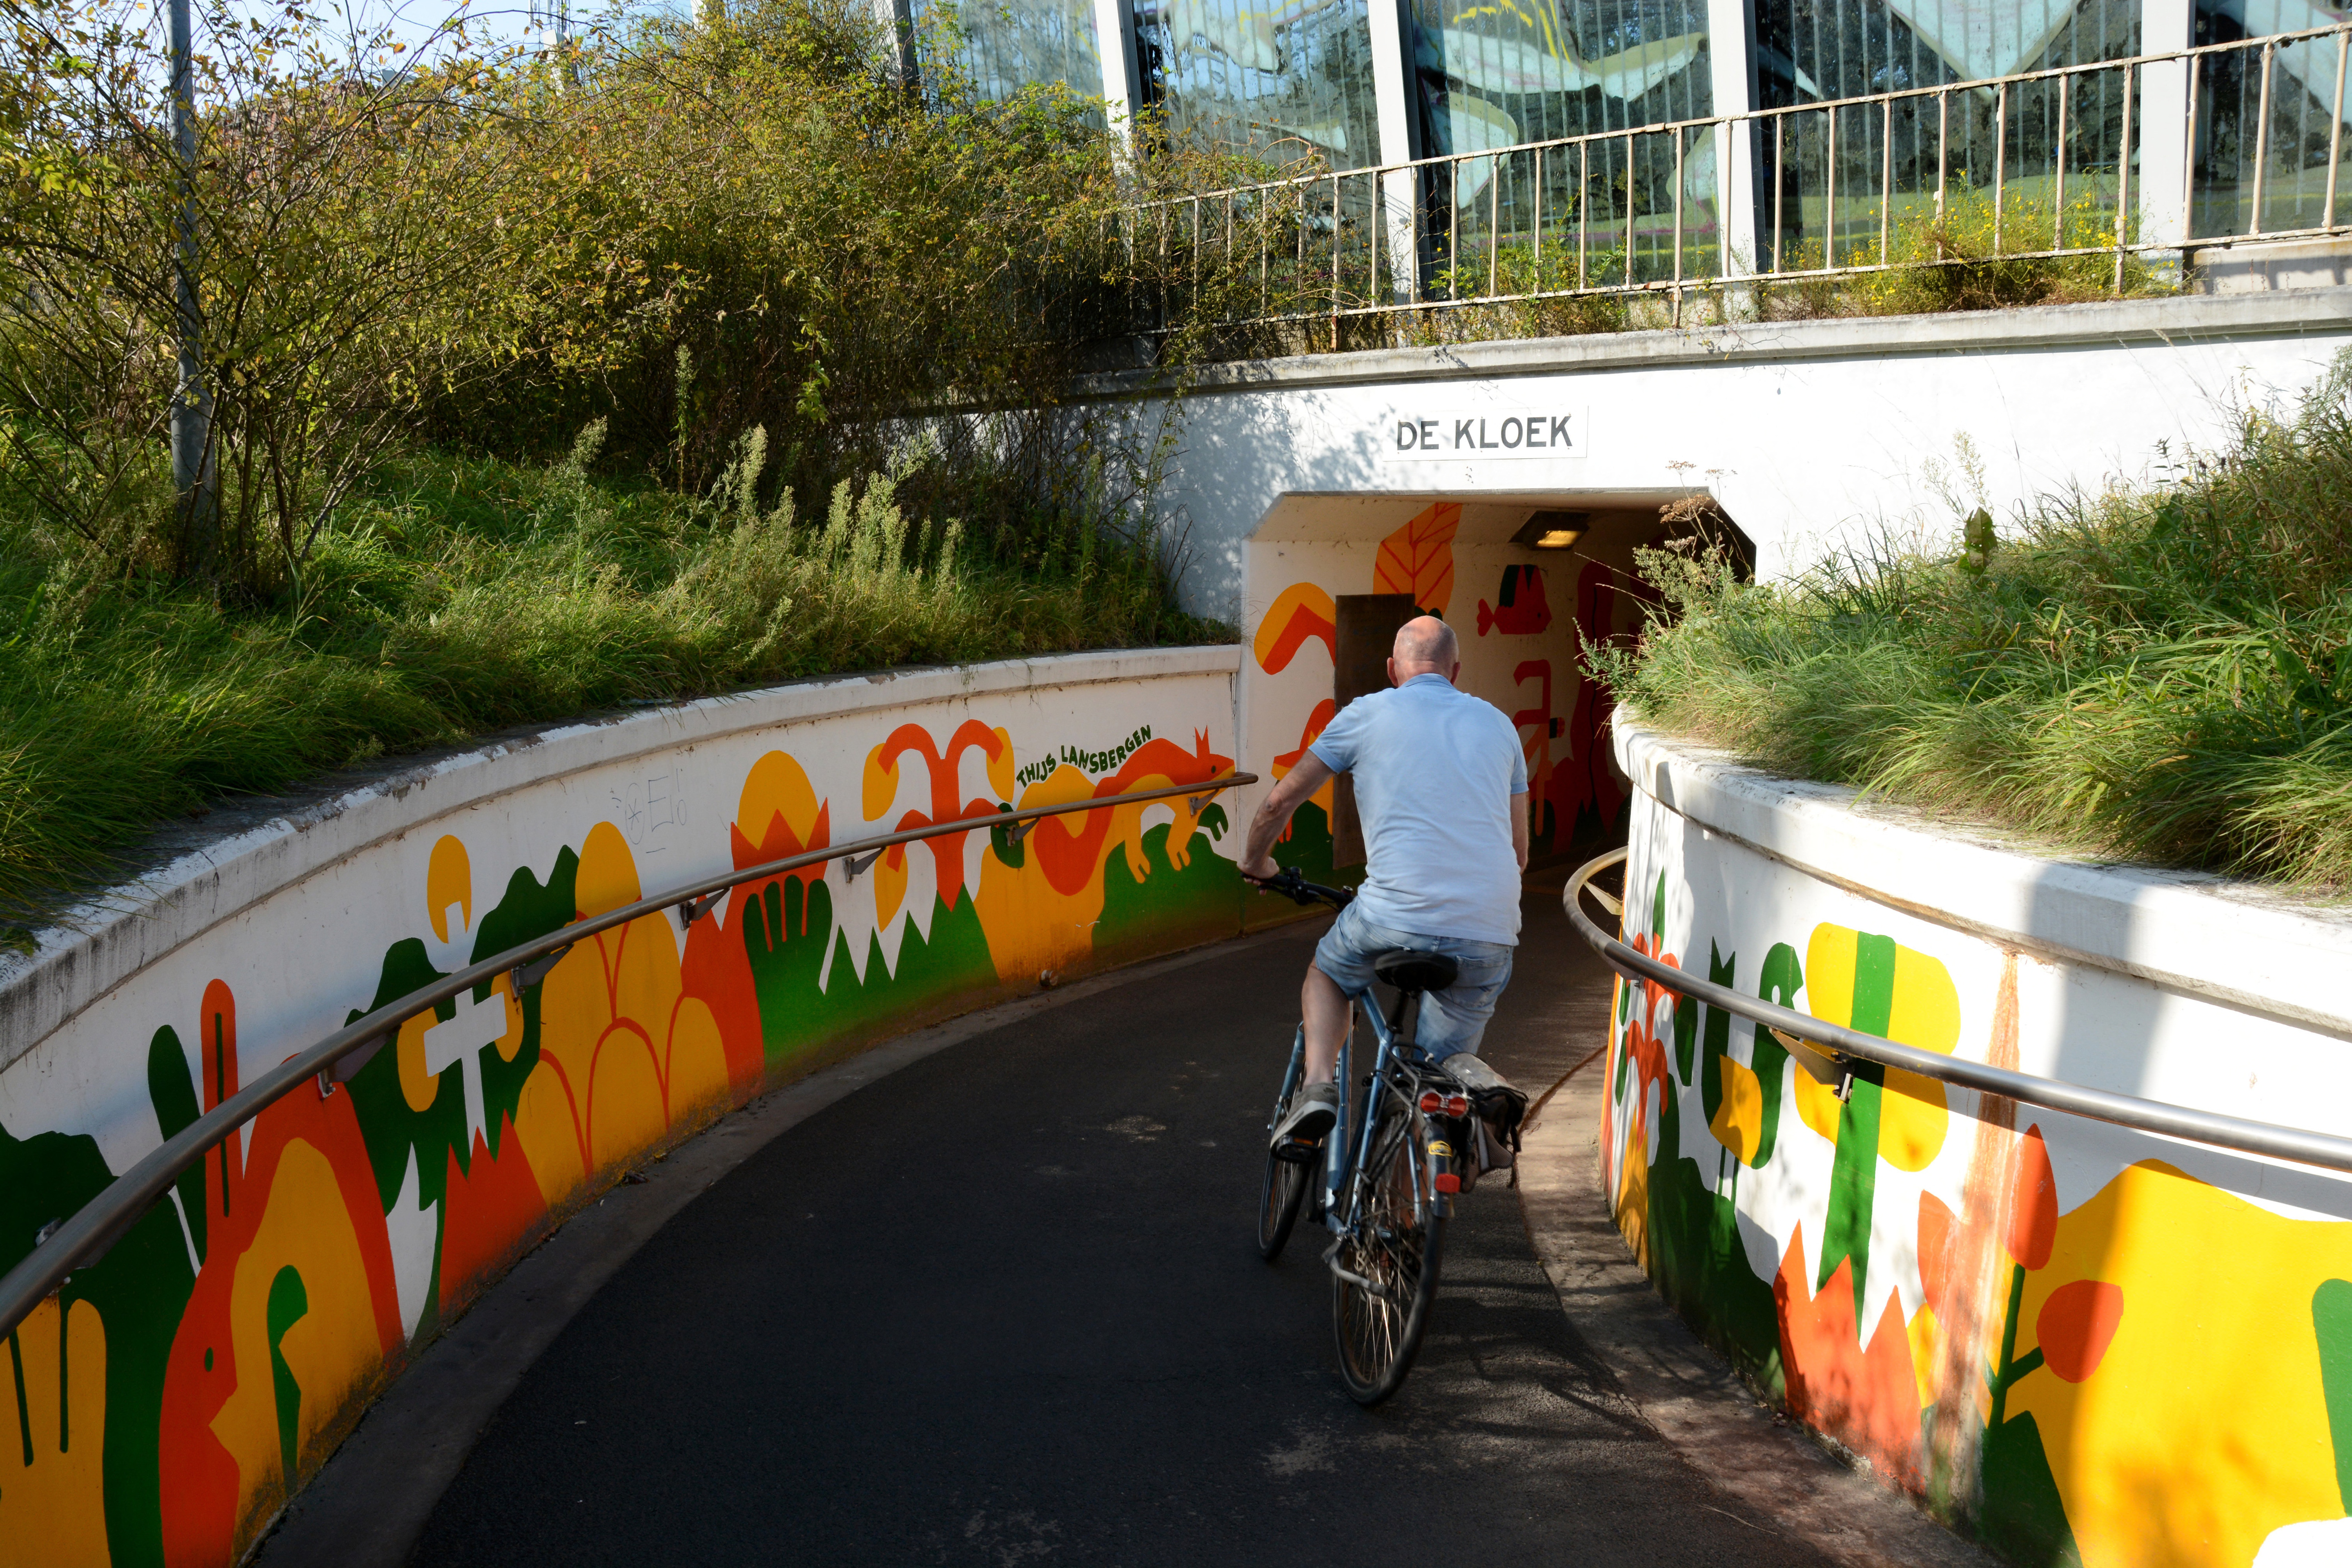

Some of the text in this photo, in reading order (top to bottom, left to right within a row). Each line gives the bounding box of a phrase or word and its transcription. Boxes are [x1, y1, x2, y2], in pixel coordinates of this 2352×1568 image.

[1397, 416, 1573, 450] DE KLOEK
[1016, 724, 1151, 788] THIJS LANSBERGEN
